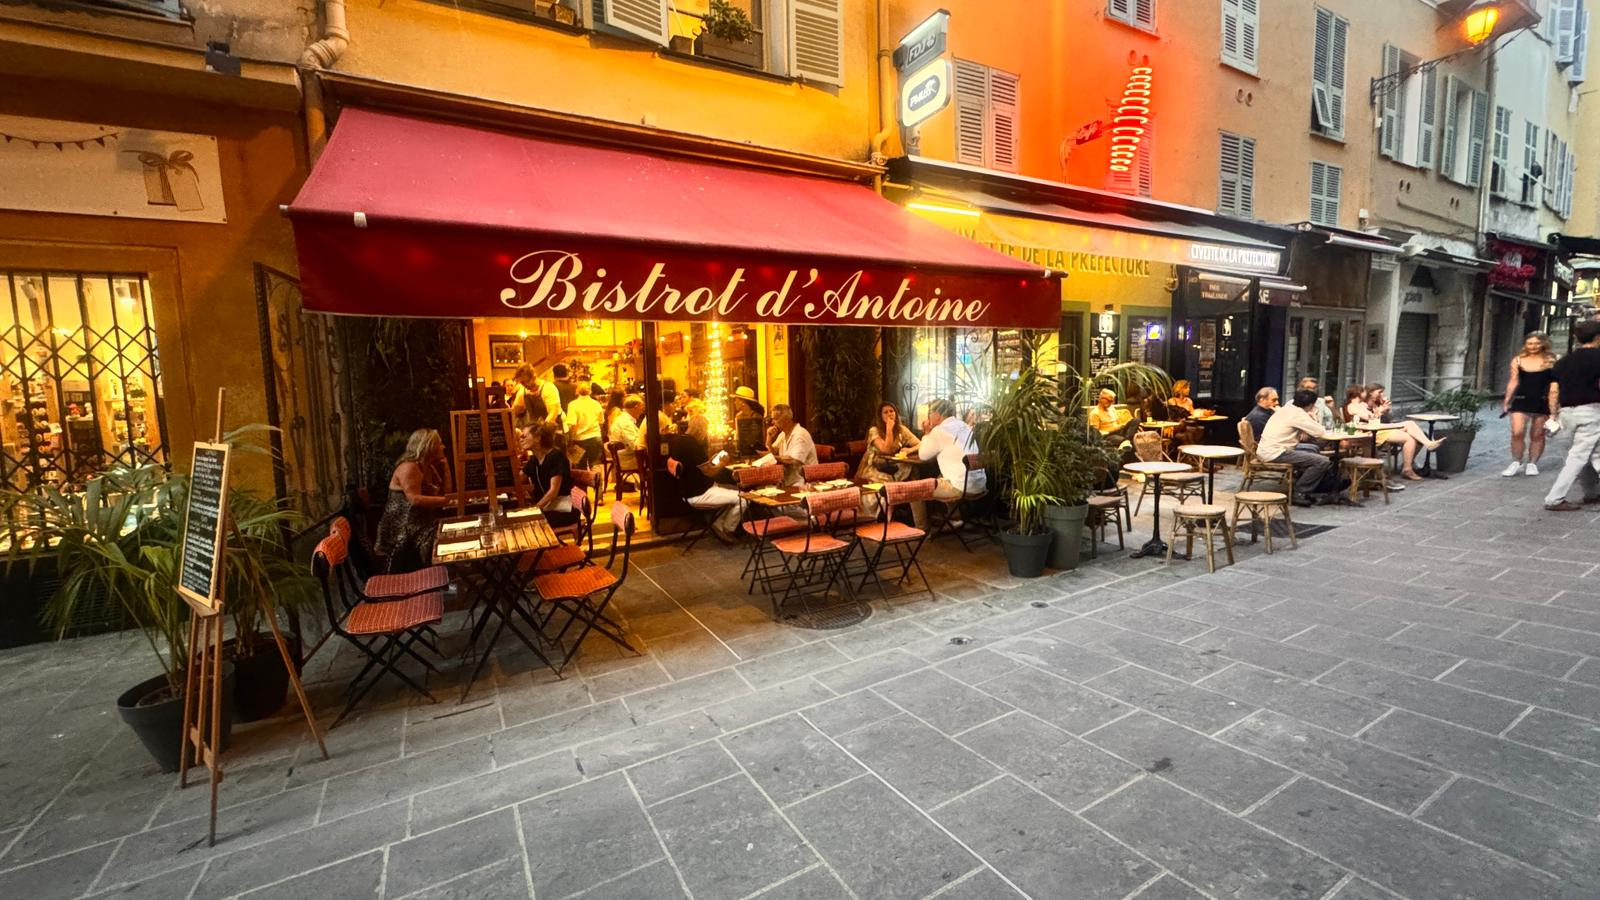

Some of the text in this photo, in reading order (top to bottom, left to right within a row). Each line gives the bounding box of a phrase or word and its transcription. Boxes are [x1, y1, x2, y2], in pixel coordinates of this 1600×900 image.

[909, 39, 927, 62] FDJ
[1046, 248, 1065, 268] LA
[1220, 248, 1230, 262] DE
[500, 249, 992, 322] Bistrot d'Antoine
